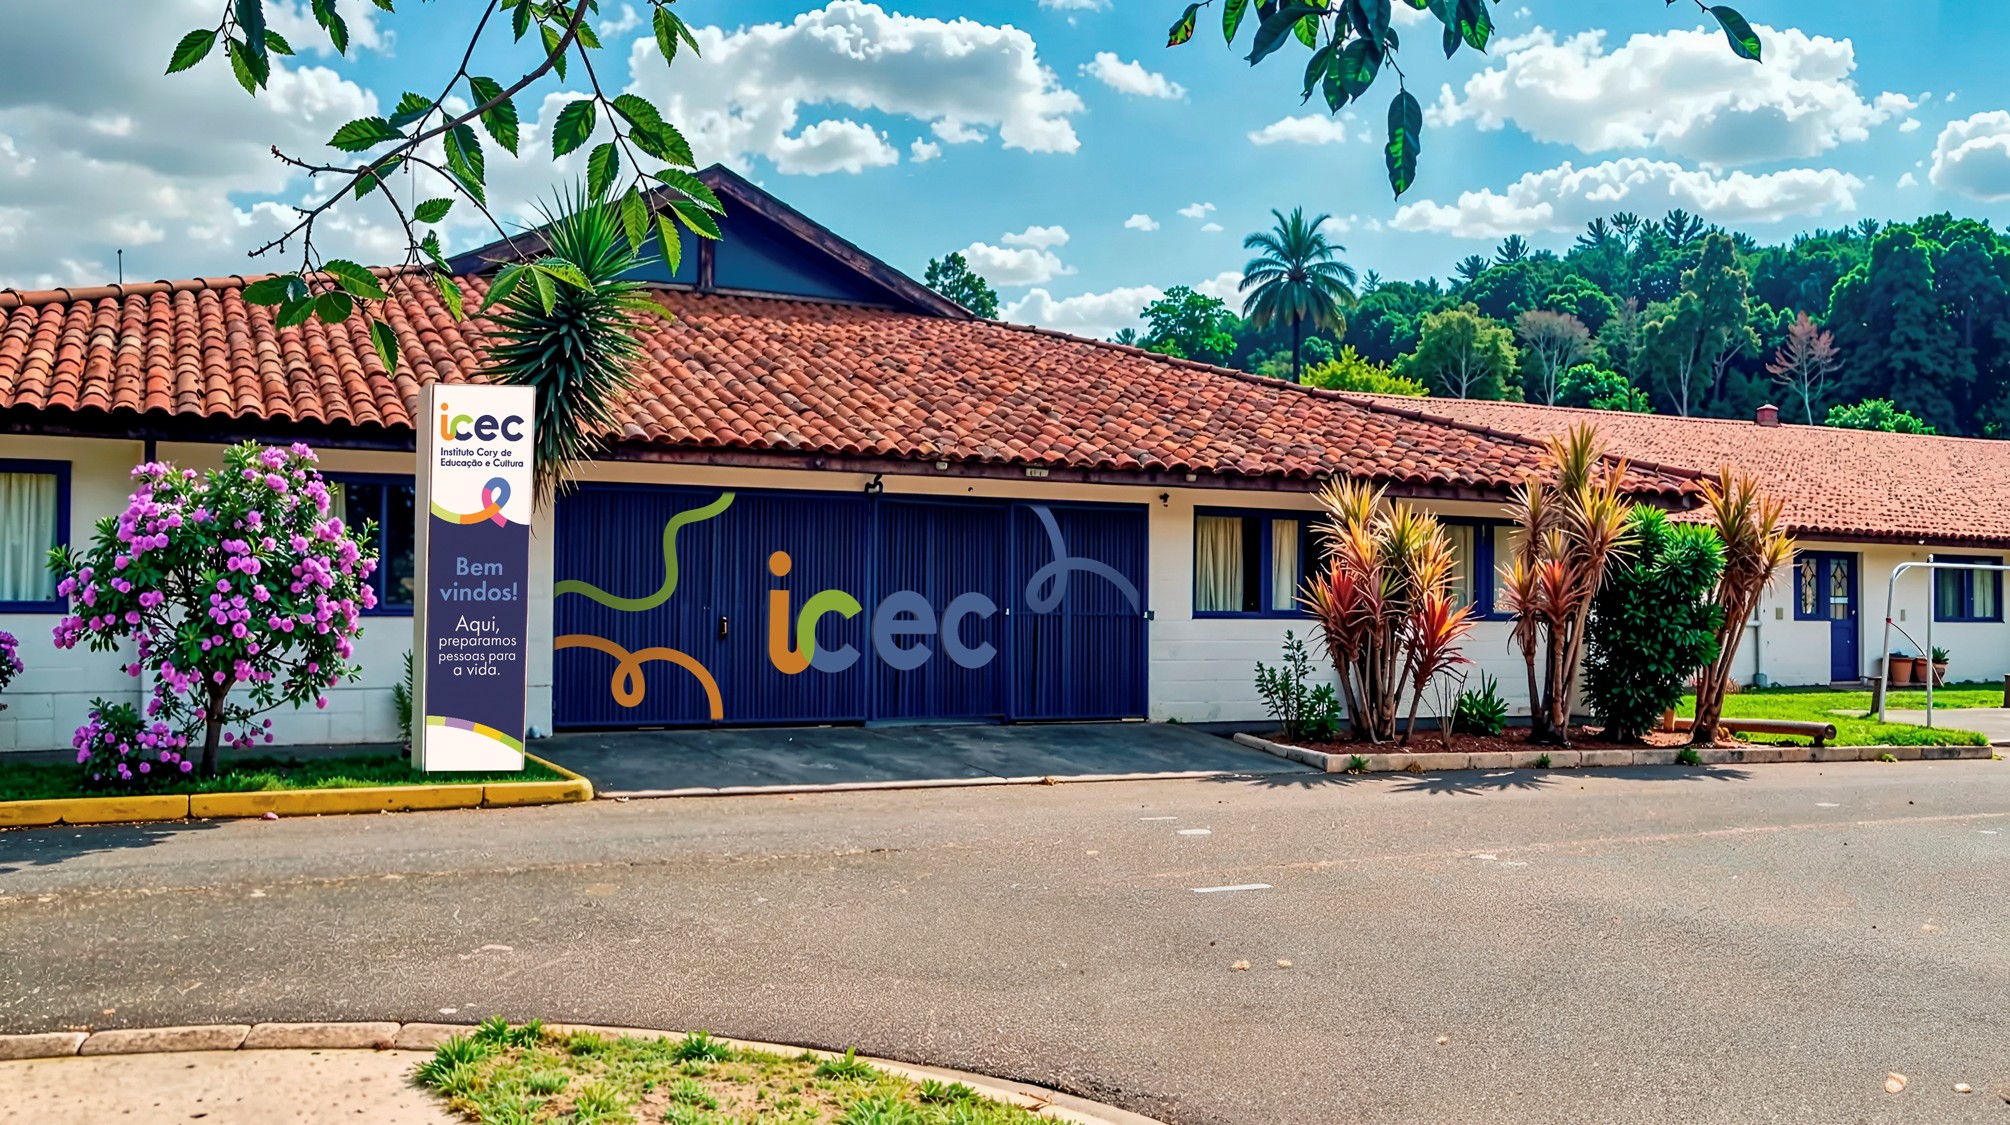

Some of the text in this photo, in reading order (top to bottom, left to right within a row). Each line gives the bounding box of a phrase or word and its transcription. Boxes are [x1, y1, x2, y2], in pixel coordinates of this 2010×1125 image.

[441, 402, 524, 442] icec
[440, 447, 512, 458] Instituto Cory de
[440, 458, 483, 468] Educação
[493, 458, 524, 468] Cultura
[456, 557, 503, 576] Bem
[440, 580, 518, 601] vindos!
[767, 550, 998, 675] icec
[455, 615, 500, 636] Aqui,
[438, 638, 517, 650] preparamos
[438, 653, 516, 665] pessoas para
[453, 662, 501, 676] a vida.
